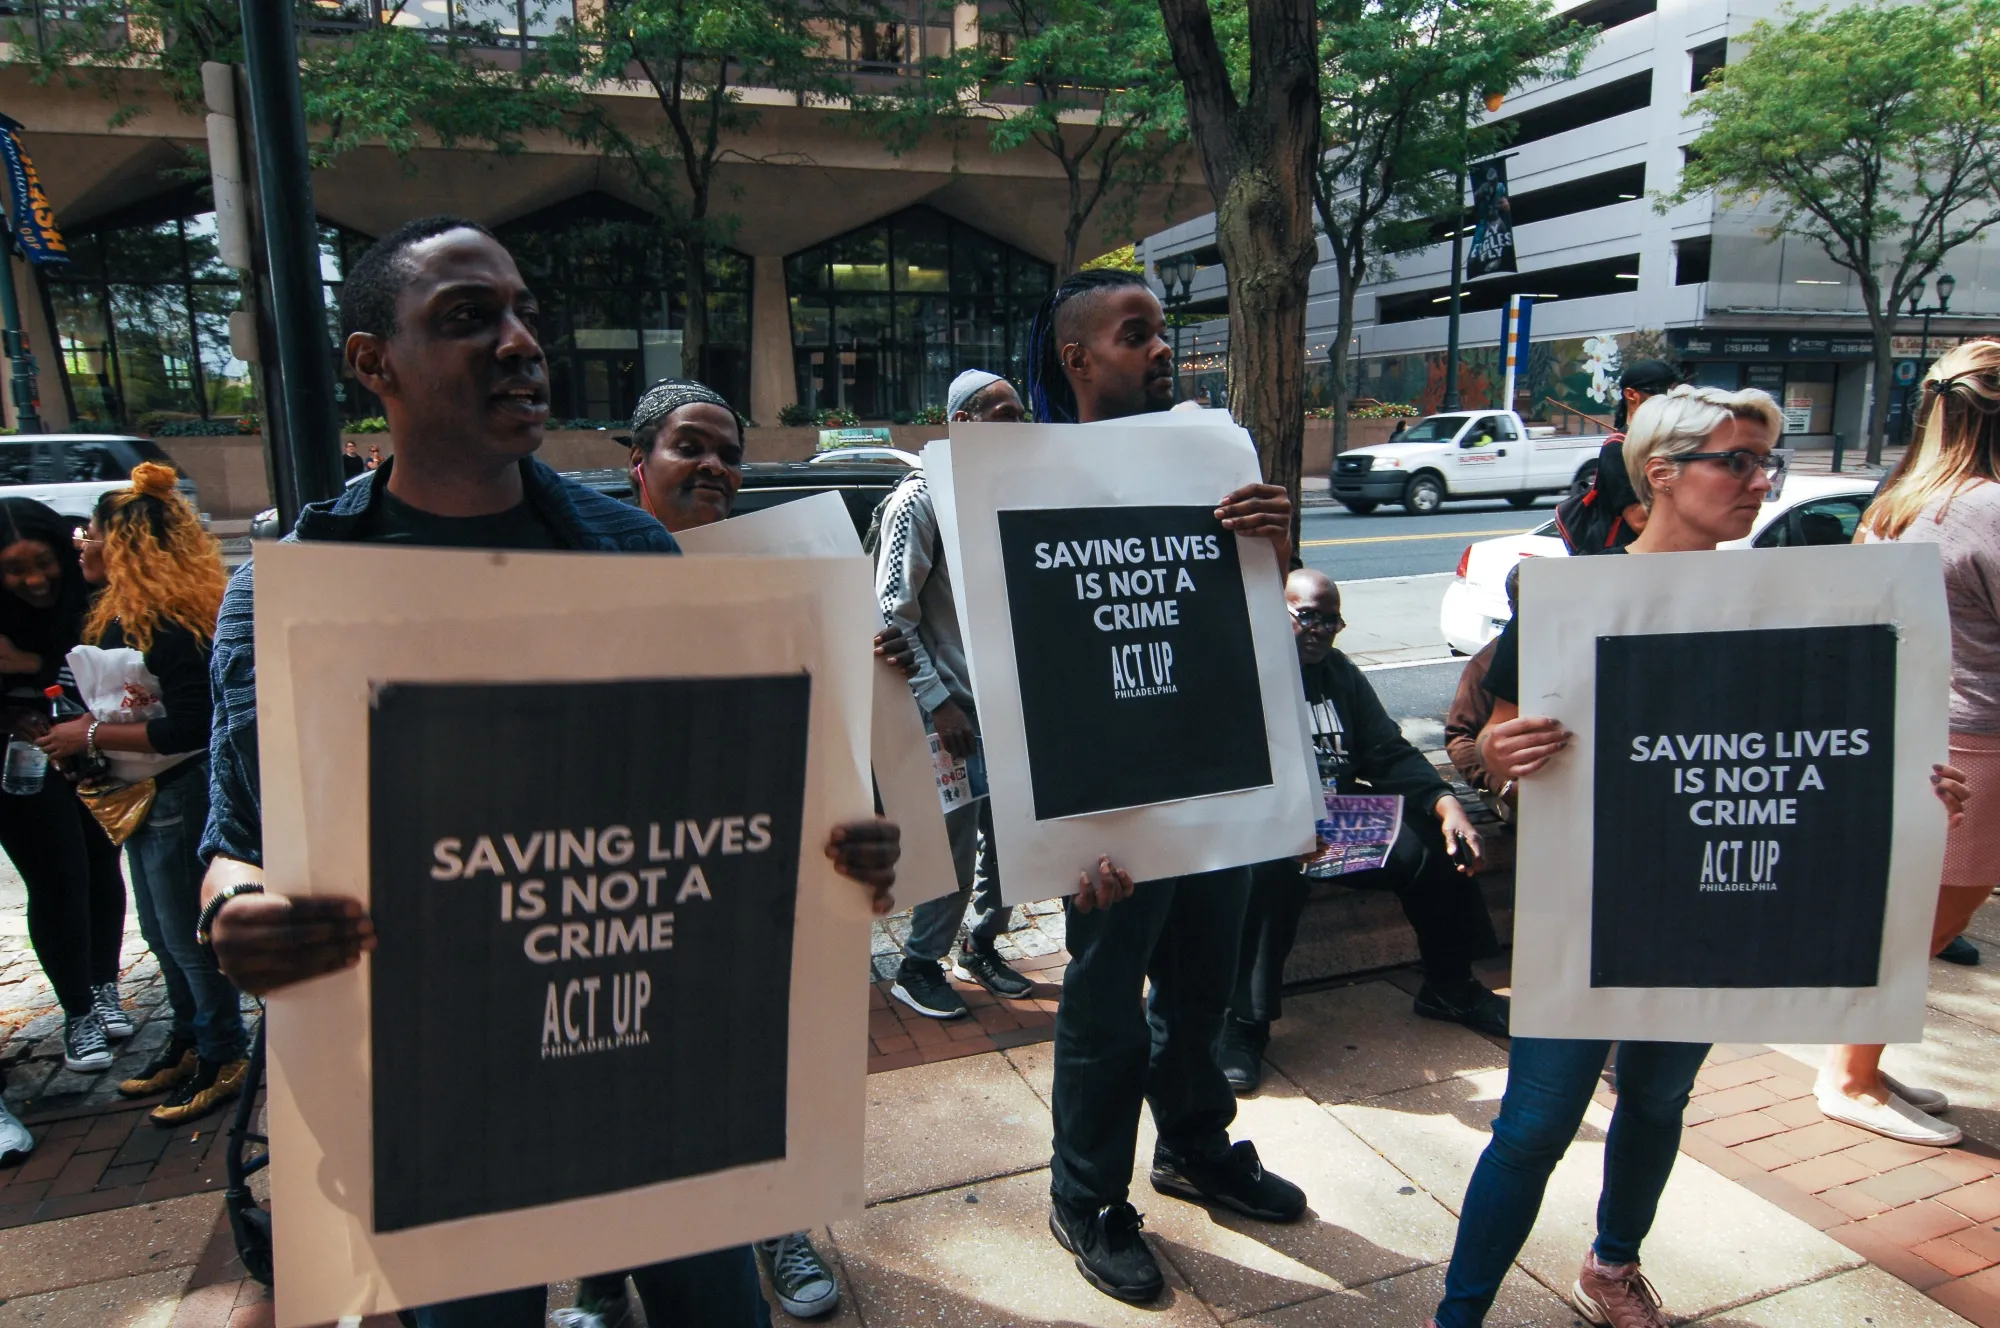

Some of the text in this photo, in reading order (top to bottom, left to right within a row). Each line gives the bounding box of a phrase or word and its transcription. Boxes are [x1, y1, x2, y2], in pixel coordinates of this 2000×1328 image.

[19, 219, 43, 250] OOP
[1034, 535, 1220, 569] SAVING LIVES
[1076, 567, 1196, 599] IS NOT A
[1093, 600, 1180, 631] CRIME
[1111, 641, 1173, 690] ACT UP
[1114, 685, 1178, 699] PHILADELPHIA
[1629, 729, 1870, 761] SAVING LIVES
[1674, 764, 1824, 793] IS NOT A
[1689, 799, 1797, 826] CRIME
[430, 814, 772, 880] SAVING LIVES
[1700, 840, 1780, 883] ACT UP
[501, 864, 712, 922] IS NOT A
[1700, 883, 1777, 891] PHILADELPHIA
[524, 912, 674, 964] CRIME
[542, 971, 651, 1044] ACT UP
[541, 1031, 650, 1060] PHILADELPHIA
